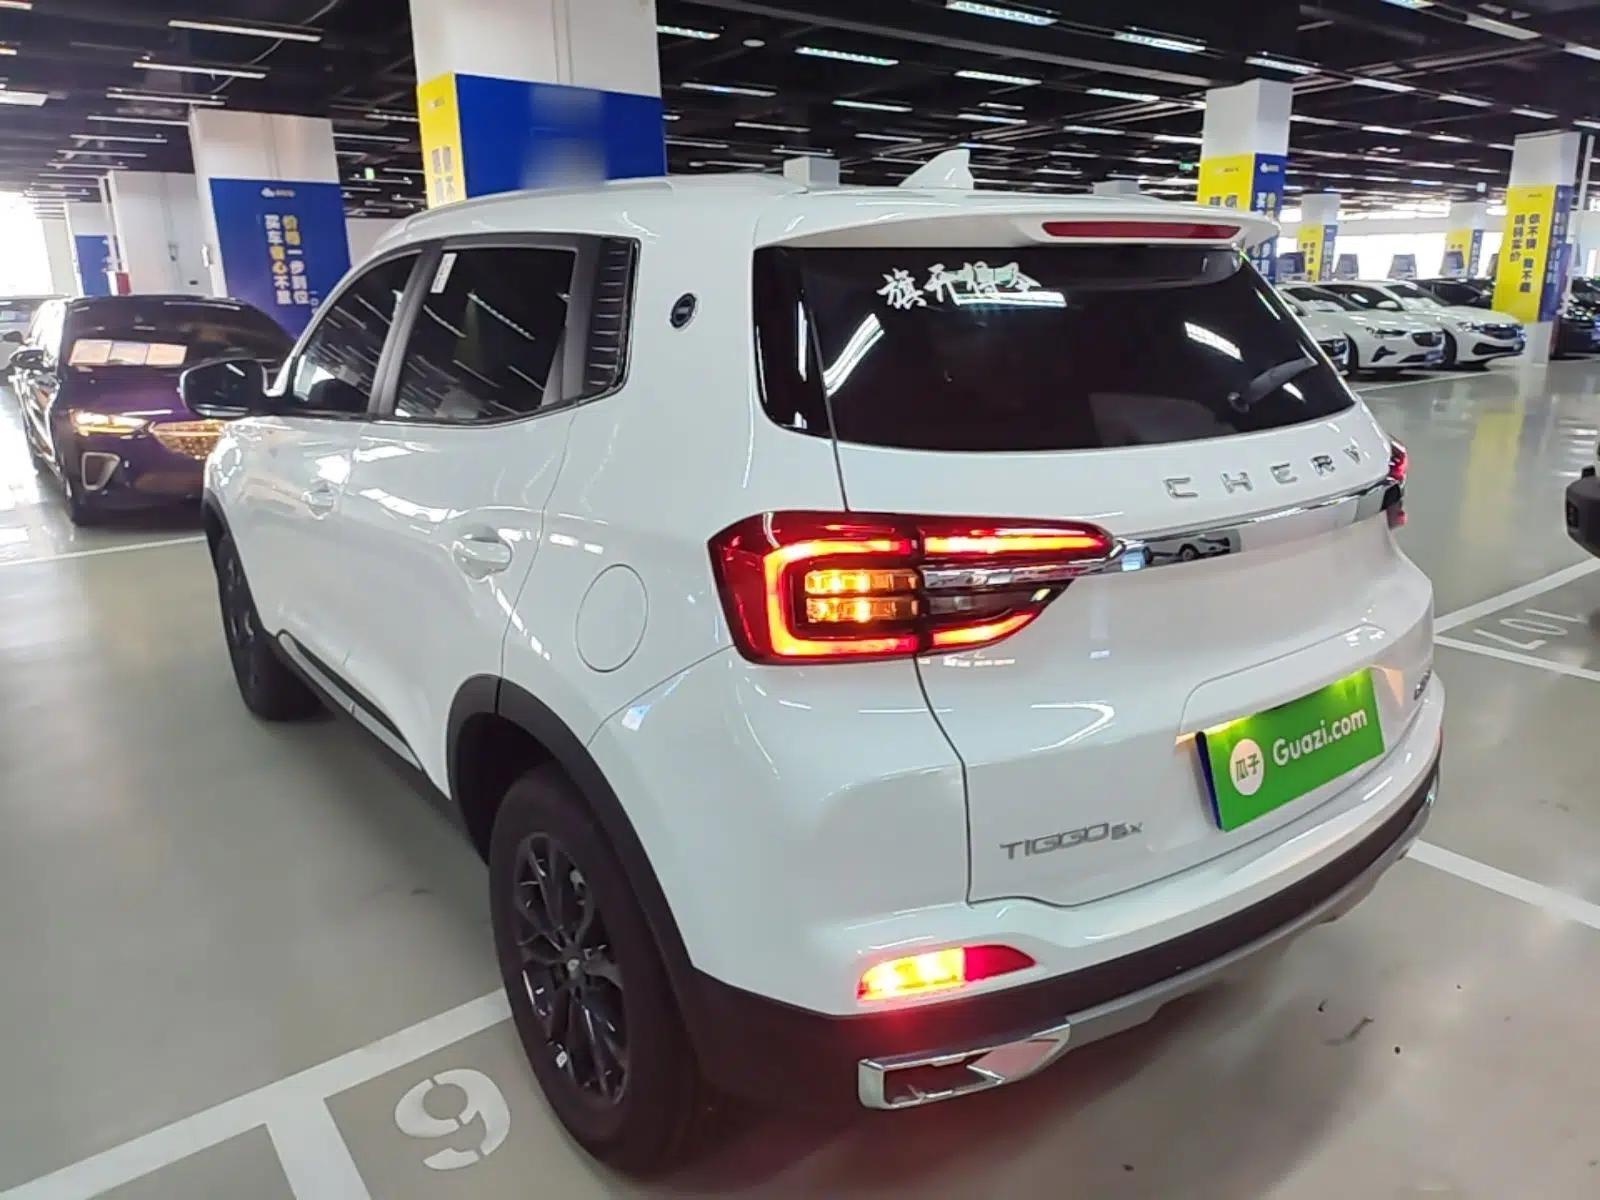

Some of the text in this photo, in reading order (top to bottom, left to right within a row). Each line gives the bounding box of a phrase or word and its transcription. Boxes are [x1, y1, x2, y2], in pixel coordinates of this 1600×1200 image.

[1163, 440, 1363, 498] CHERY
[1272, 708, 1369, 767] Guazi.com
[1235, 752, 1261, 782] 瓜子
